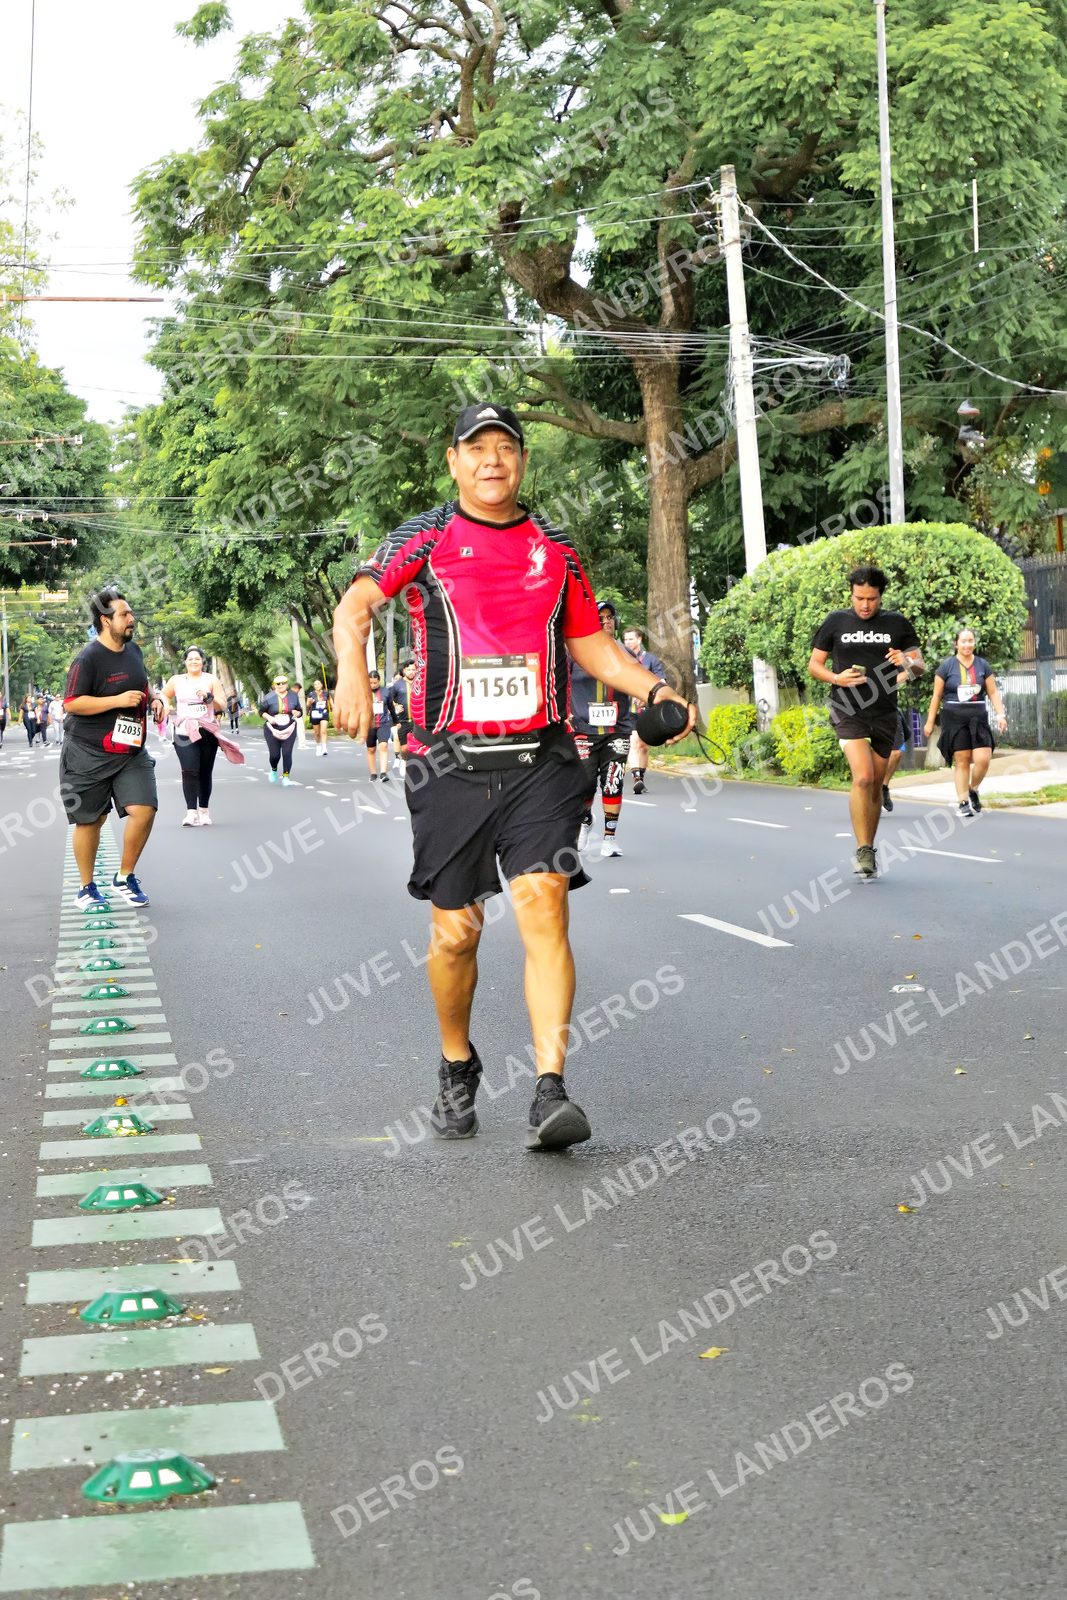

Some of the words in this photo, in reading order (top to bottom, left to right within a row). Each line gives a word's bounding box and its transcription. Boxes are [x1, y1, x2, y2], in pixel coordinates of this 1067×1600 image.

[841, 630, 892, 644] adidas
[466, 675, 529, 698] 11561
[591, 709, 615, 718] 12117
[117, 723, 142, 737] 12035
